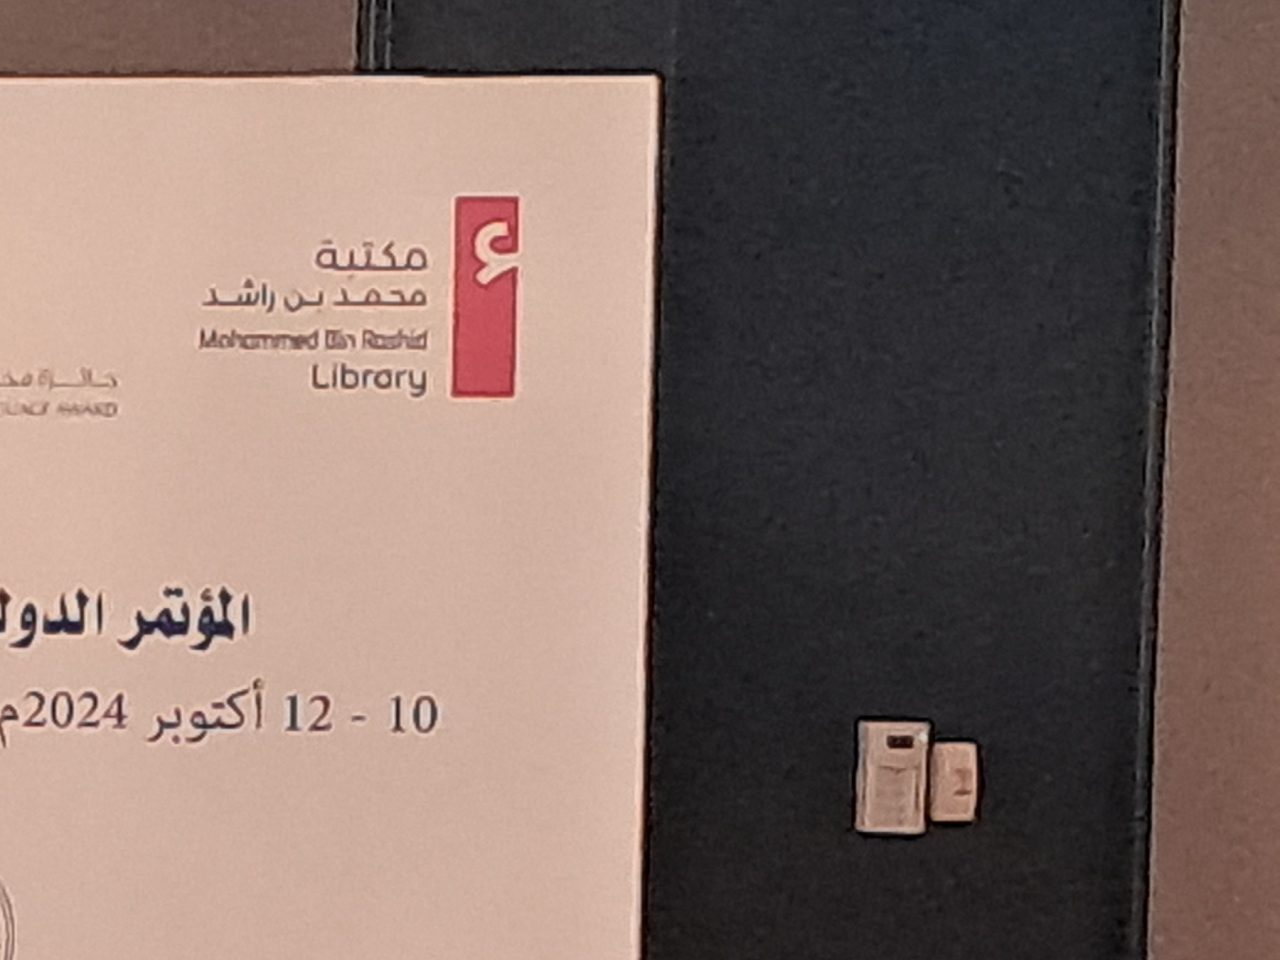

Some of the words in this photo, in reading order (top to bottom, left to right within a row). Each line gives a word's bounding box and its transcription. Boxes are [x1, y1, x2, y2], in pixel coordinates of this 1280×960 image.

[315, 239, 428, 280] مكتبة
[202, 278, 276, 313] راشد
[284, 287, 324, 313] بن
[333, 288, 428, 307] محمد
[198, 328, 318, 351] Mohammed
[324, 329, 356, 350] Bin
[362, 329, 428, 351] Rashid
[311, 362, 428, 398] Library
[117, 586, 249, 651] المؤتمر
[146, 677, 266, 745] أكتوبر
[283, 693, 334, 733] 12
[389, 694, 440, 734] 10
